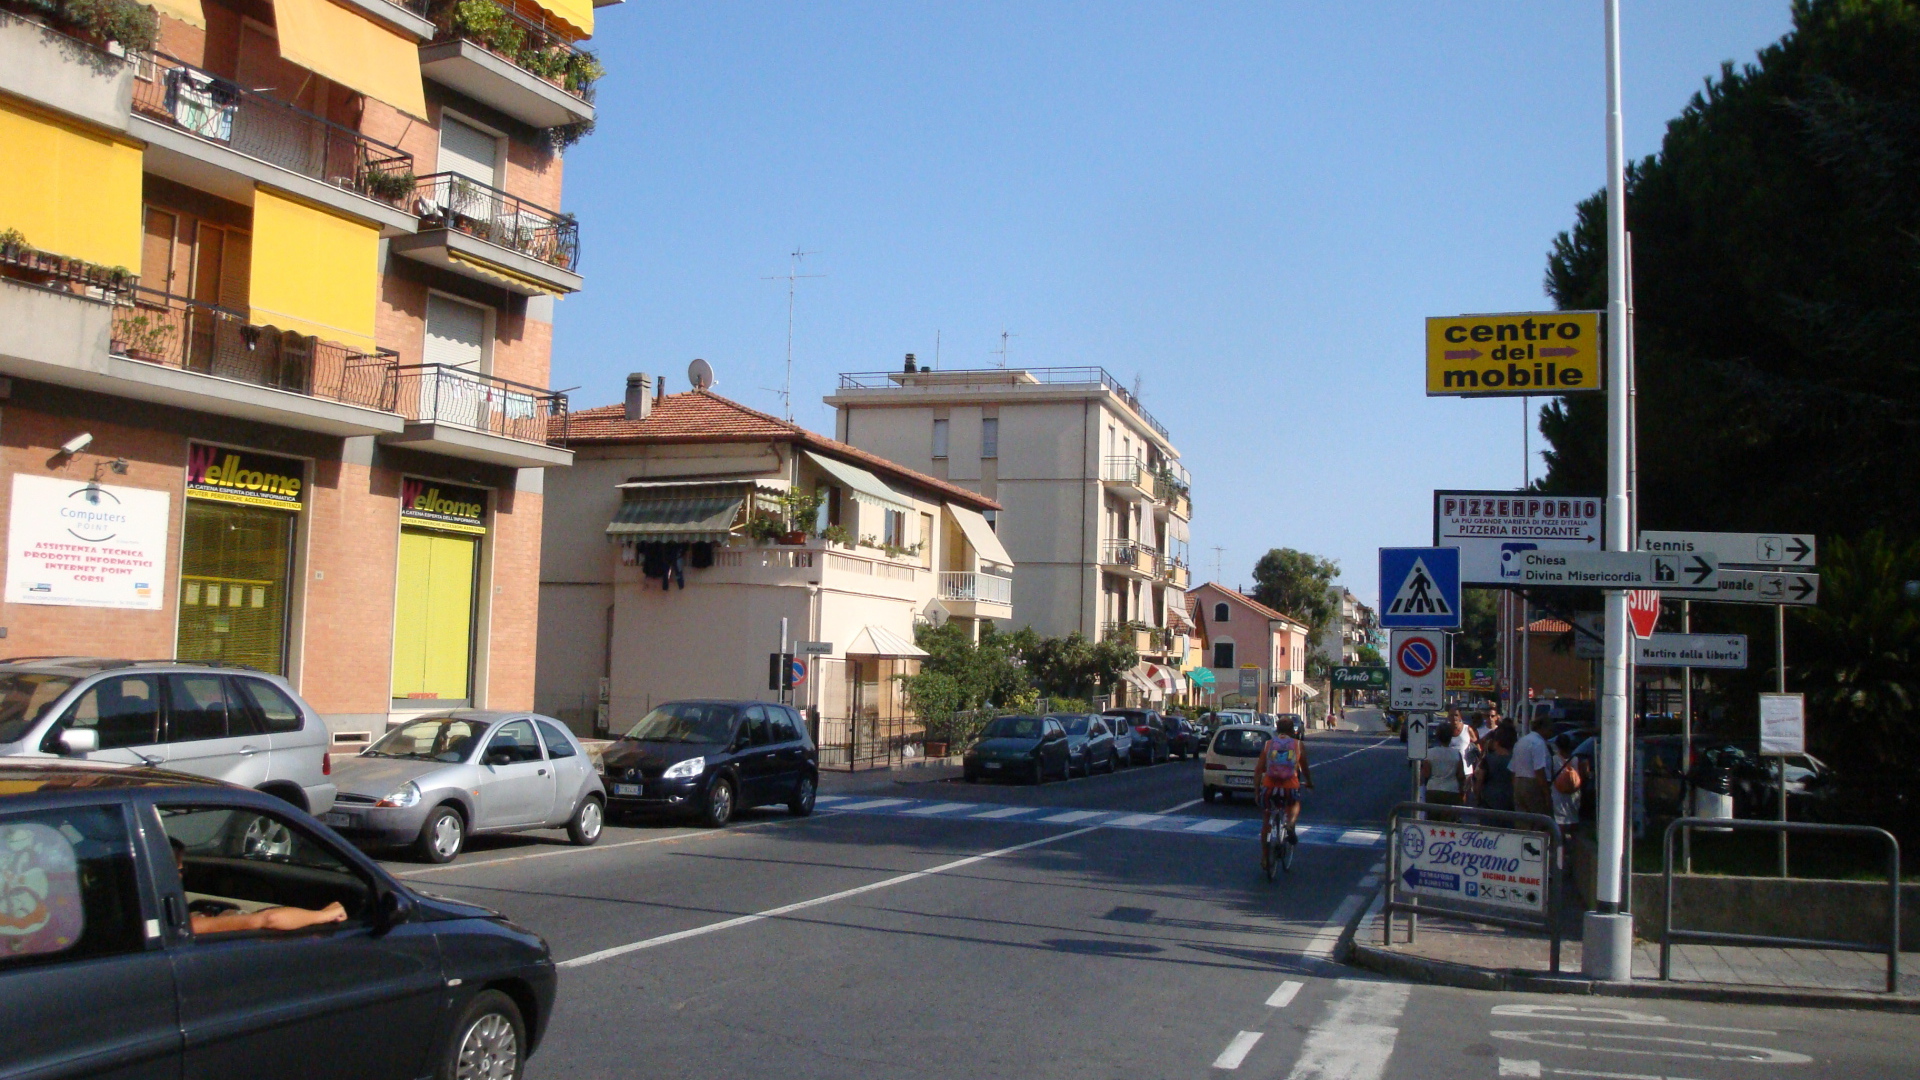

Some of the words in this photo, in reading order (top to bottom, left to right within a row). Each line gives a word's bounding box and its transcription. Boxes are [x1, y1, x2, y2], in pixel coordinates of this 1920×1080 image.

[1444, 319, 1581, 343] centro
[1491, 344, 1534, 361] del
[1444, 363, 1583, 388] mobile
[188, 444, 301, 496] Wellcome
[195, 484, 218, 492] CATENA
[219, 487, 244, 495] ESPERTA
[402, 479, 481, 519] Wellcome
[60, 507, 126, 523] Computers
[1444, 498, 1597, 519] PIZZEMPORIO
[77, 522, 108, 531] POINT
[1459, 525, 1508, 535] PIZZERIA
[1511, 526, 1580, 536] RISTORANTE
[35, 542, 97, 553] ASSISTENZA
[102, 547, 144, 558] TECNICA
[1646, 538, 1694, 552] tennis
[24, 551, 81, 561] PRODOTTI
[85, 555, 153, 568] INFORMATICI
[1526, 555, 1567, 566] Chiesa
[45, 562, 97, 572] INTERNET
[101, 566, 133, 575] POINT
[1526, 570, 1563, 581] Divina
[1568, 571, 1642, 583] Misericordia
[73, 574, 105, 583] CORSI
[1630, 590, 1657, 612] STOP
[1335, 668, 1370, 682] Punto
[1458, 831, 1504, 850] Hotel
[1429, 841, 1519, 876] Bergamo
[1482, 872, 1506, 881] VICINO
[1508, 875, 1517, 883] AL
[1519, 876, 1540, 886] MARE
